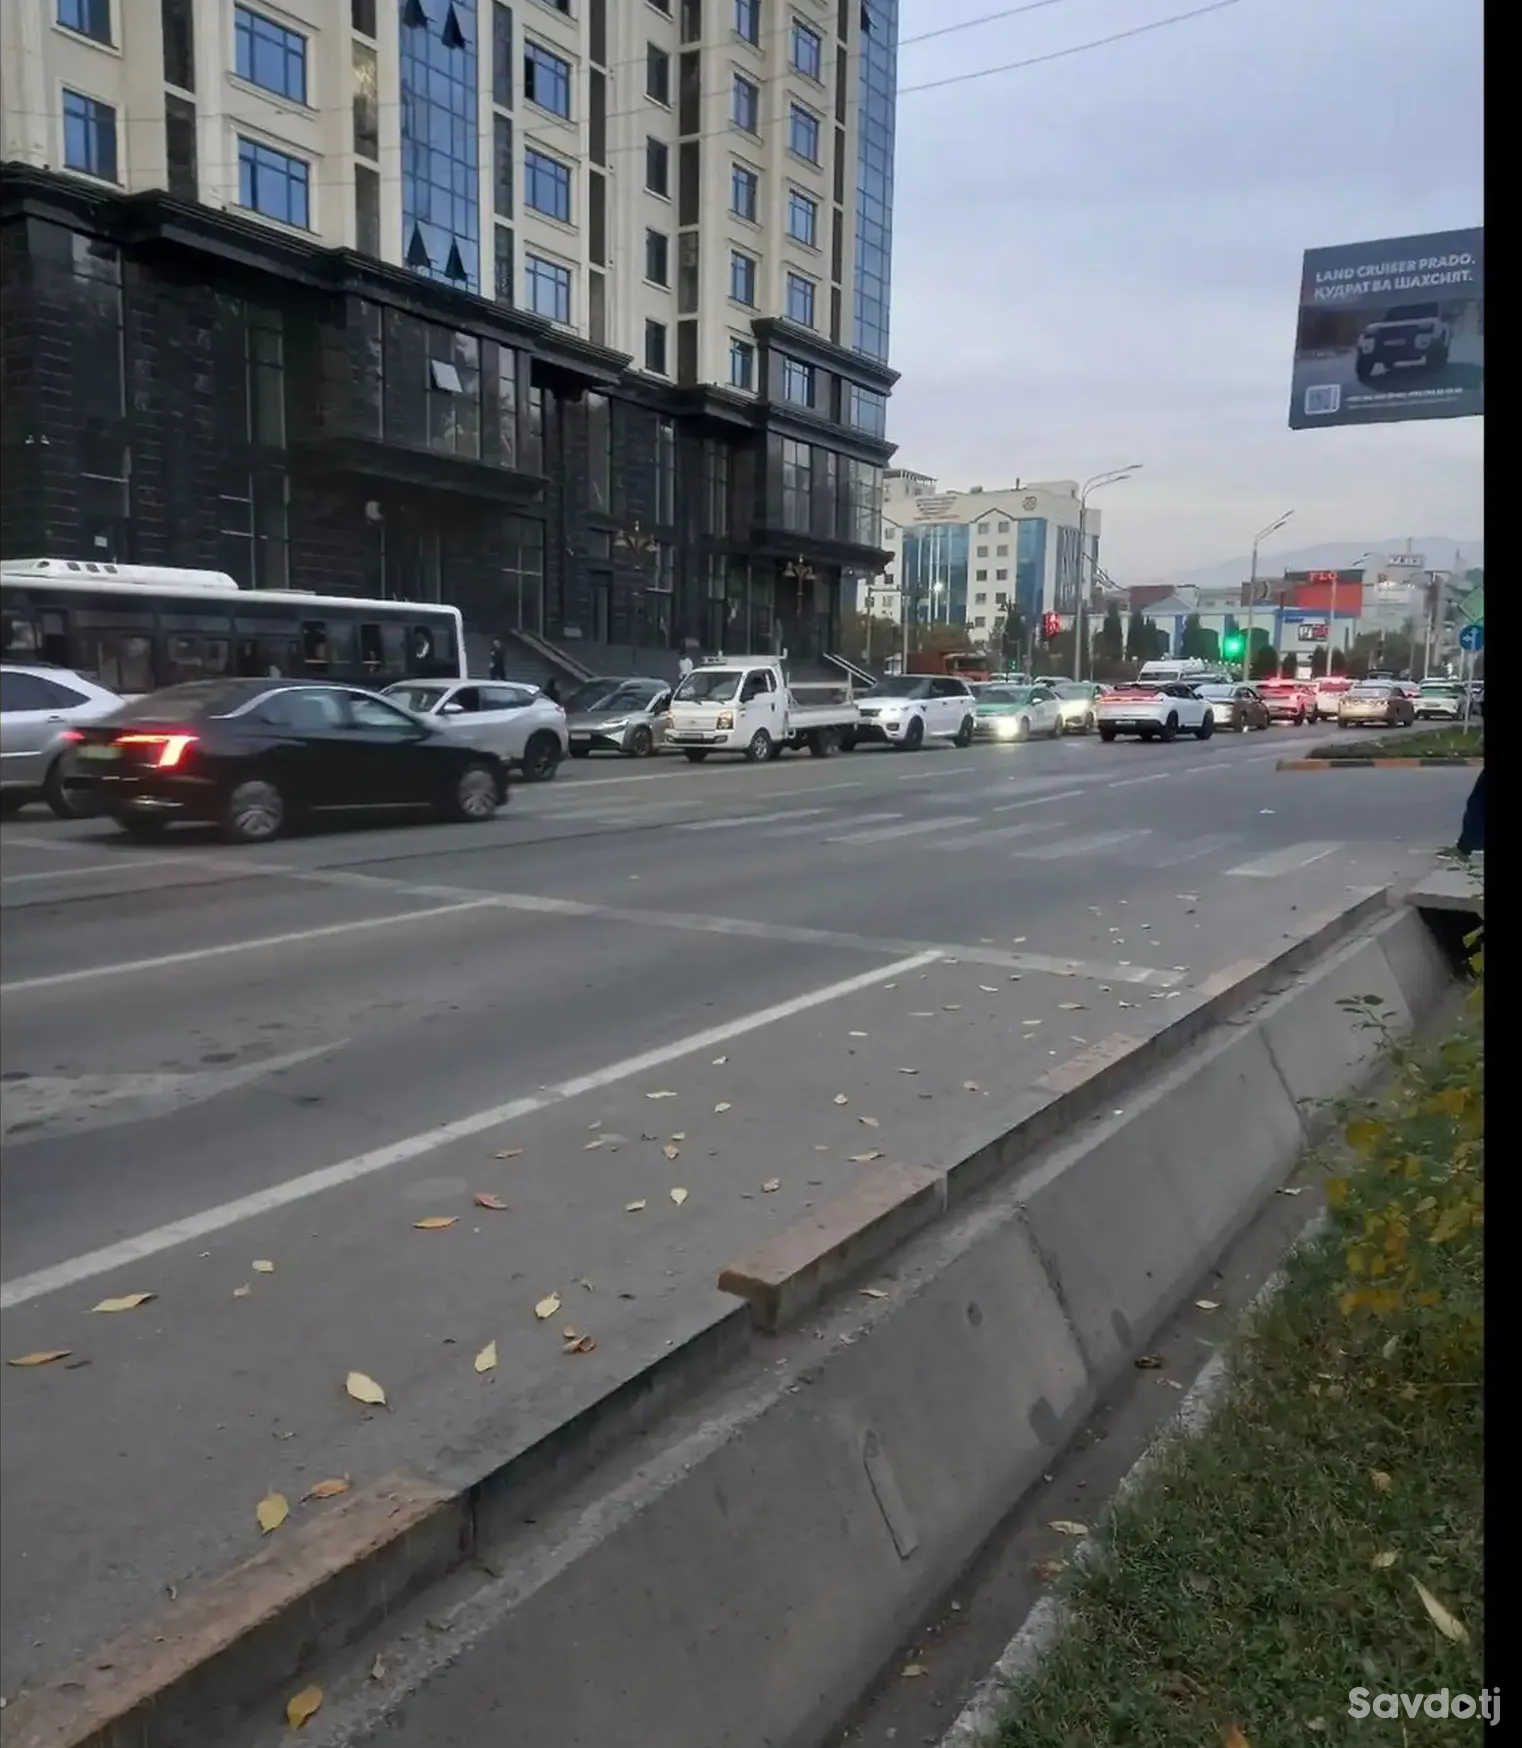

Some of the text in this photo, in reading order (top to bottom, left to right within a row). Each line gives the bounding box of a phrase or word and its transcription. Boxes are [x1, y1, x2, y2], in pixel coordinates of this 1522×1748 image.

[1316, 252, 1476, 284] LAND CRUISER PRADO.
